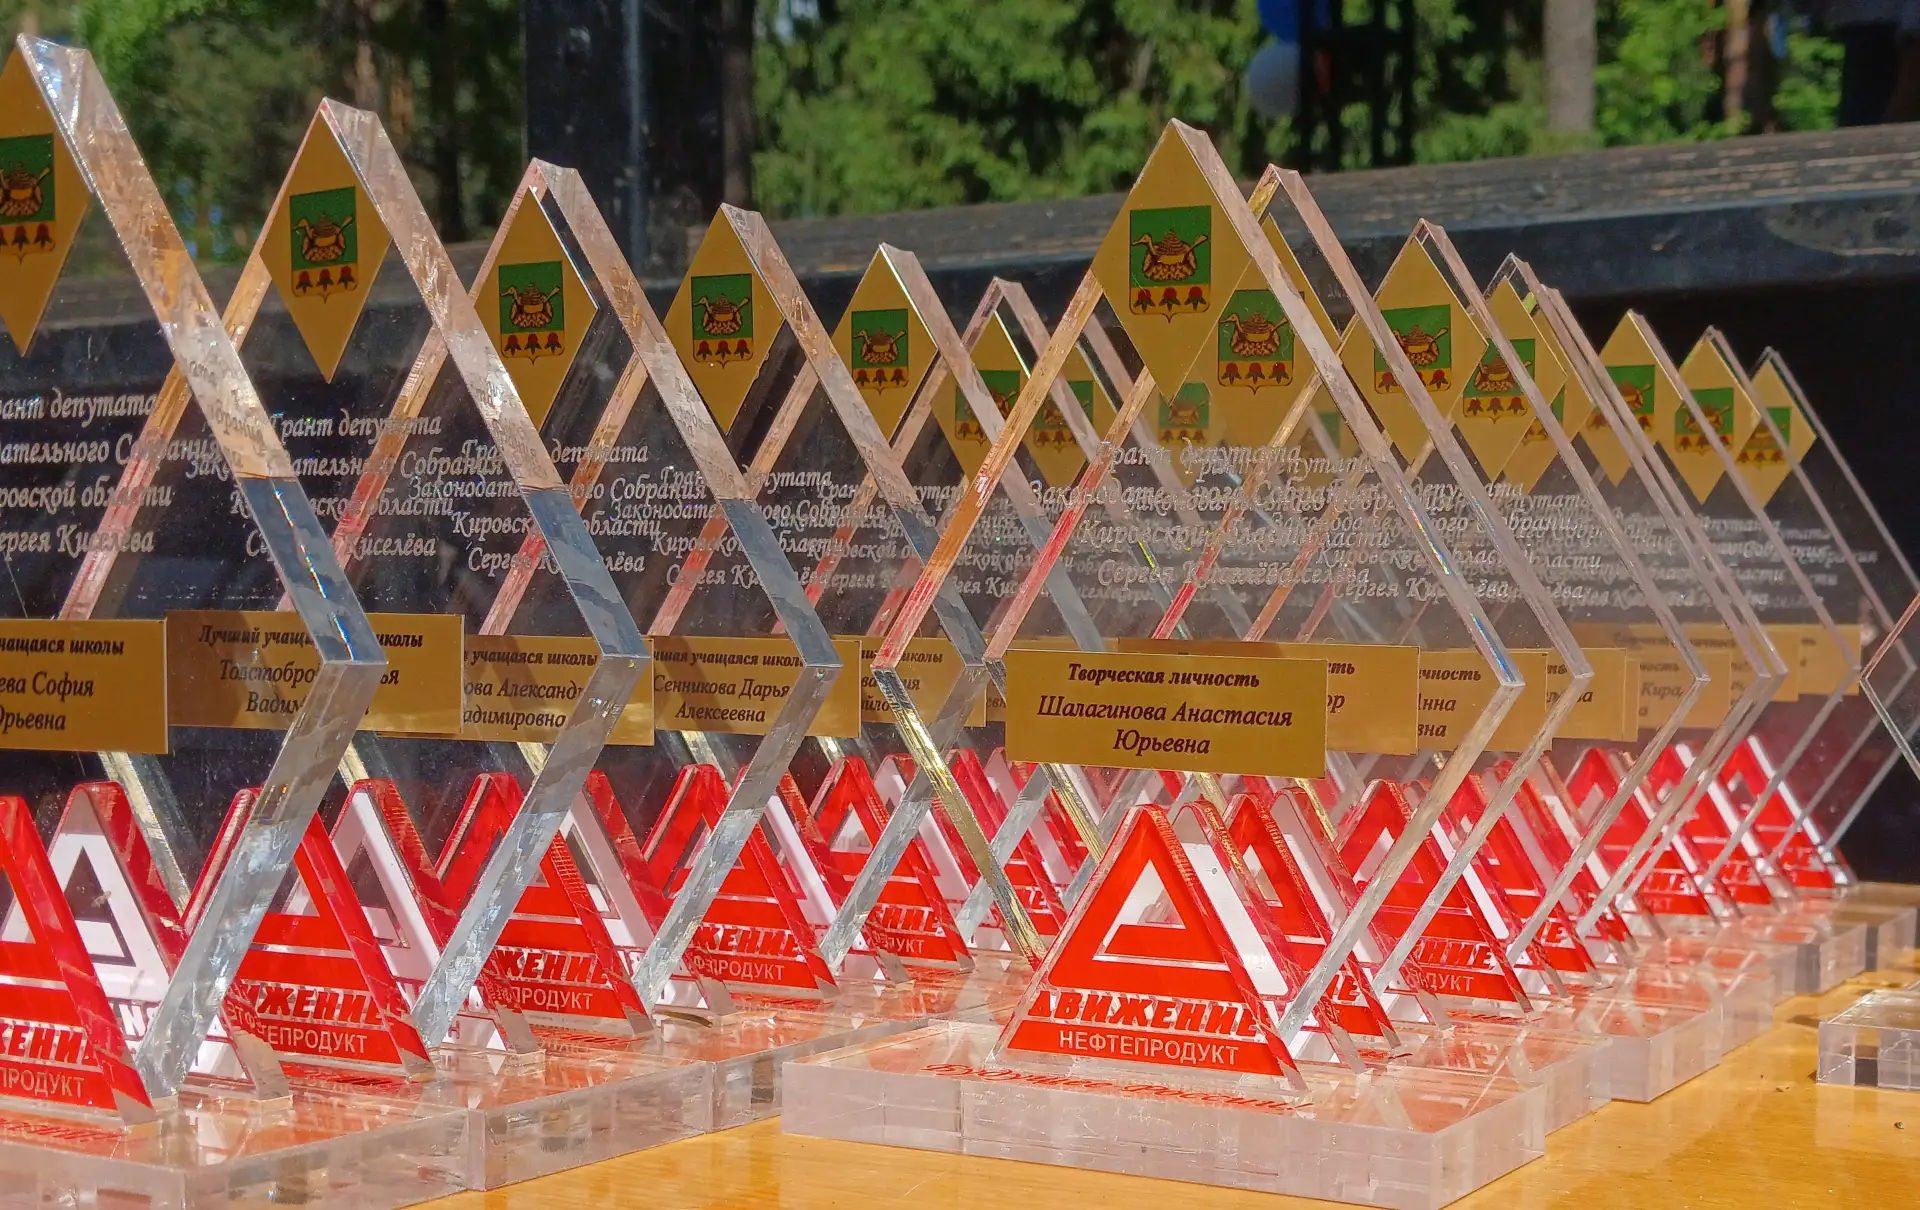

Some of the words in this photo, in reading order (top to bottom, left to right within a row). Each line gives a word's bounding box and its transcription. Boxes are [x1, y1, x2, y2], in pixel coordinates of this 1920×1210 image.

[69, 638, 125, 656] школы
[198, 624, 260, 648] Лучший
[471, 650, 544, 666] учащаяся
[547, 653, 598, 667] школы
[690, 651, 759, 668] учащаяся
[32, 670, 95, 702] София
[1068, 663, 1165, 686] Творческая
[1168, 671, 1260, 688] личность
[1419, 668, 1482, 682] чность
[654, 674, 736, 696] Сенникова
[738, 678, 791, 701] Дарья
[674, 701, 767, 723] Алексеевна
[1037, 695, 1167, 721] Шалагинова
[1171, 701, 1293, 727] Анастасия
[1113, 729, 1211, 756] Юрьевна
[1060, 1029, 1239, 1065] НЕФТЕПРОДУКТ
